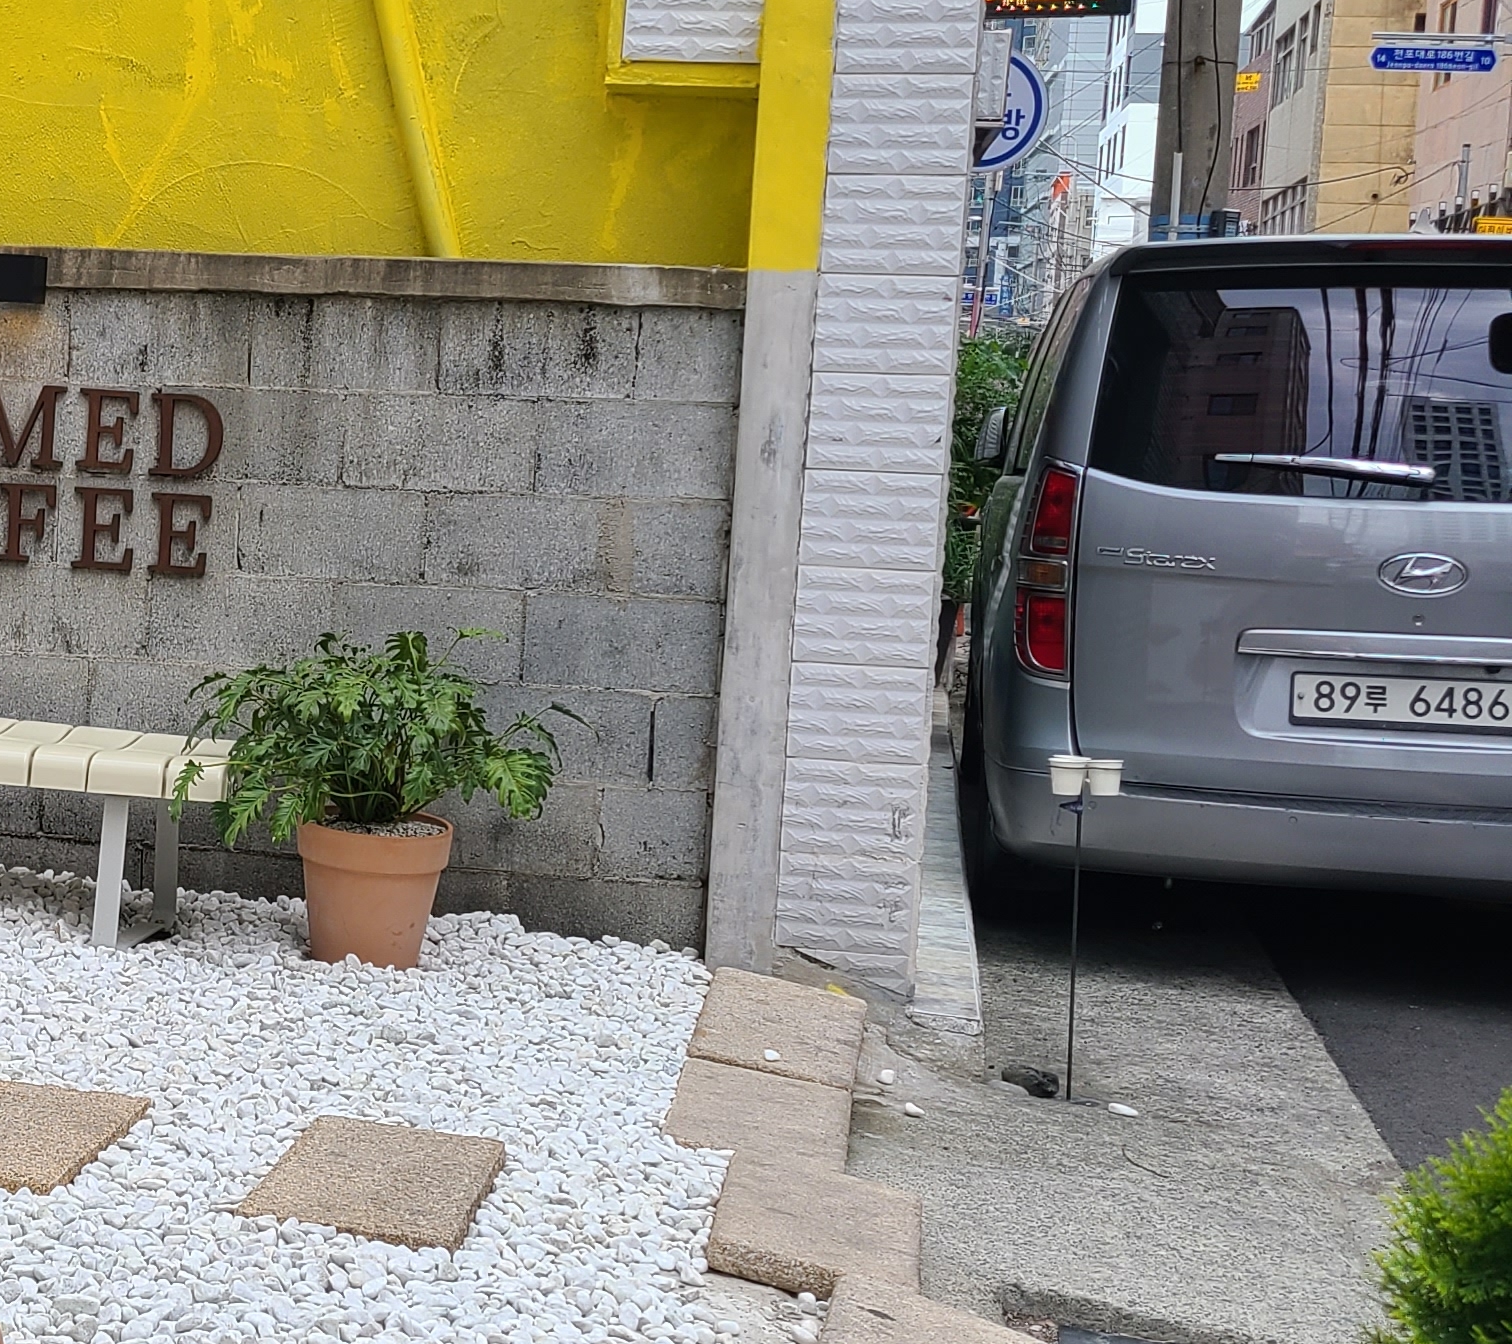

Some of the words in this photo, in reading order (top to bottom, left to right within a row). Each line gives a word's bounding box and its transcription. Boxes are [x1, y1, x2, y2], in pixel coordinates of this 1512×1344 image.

[1376, 54, 1386, 63] 14
[1481, 56, 1491, 65] 10
[1124, 548, 1216, 570] Starex
[1313, 680, 1387, 713] 89루
[1409, 685, 1510, 721] 6486
